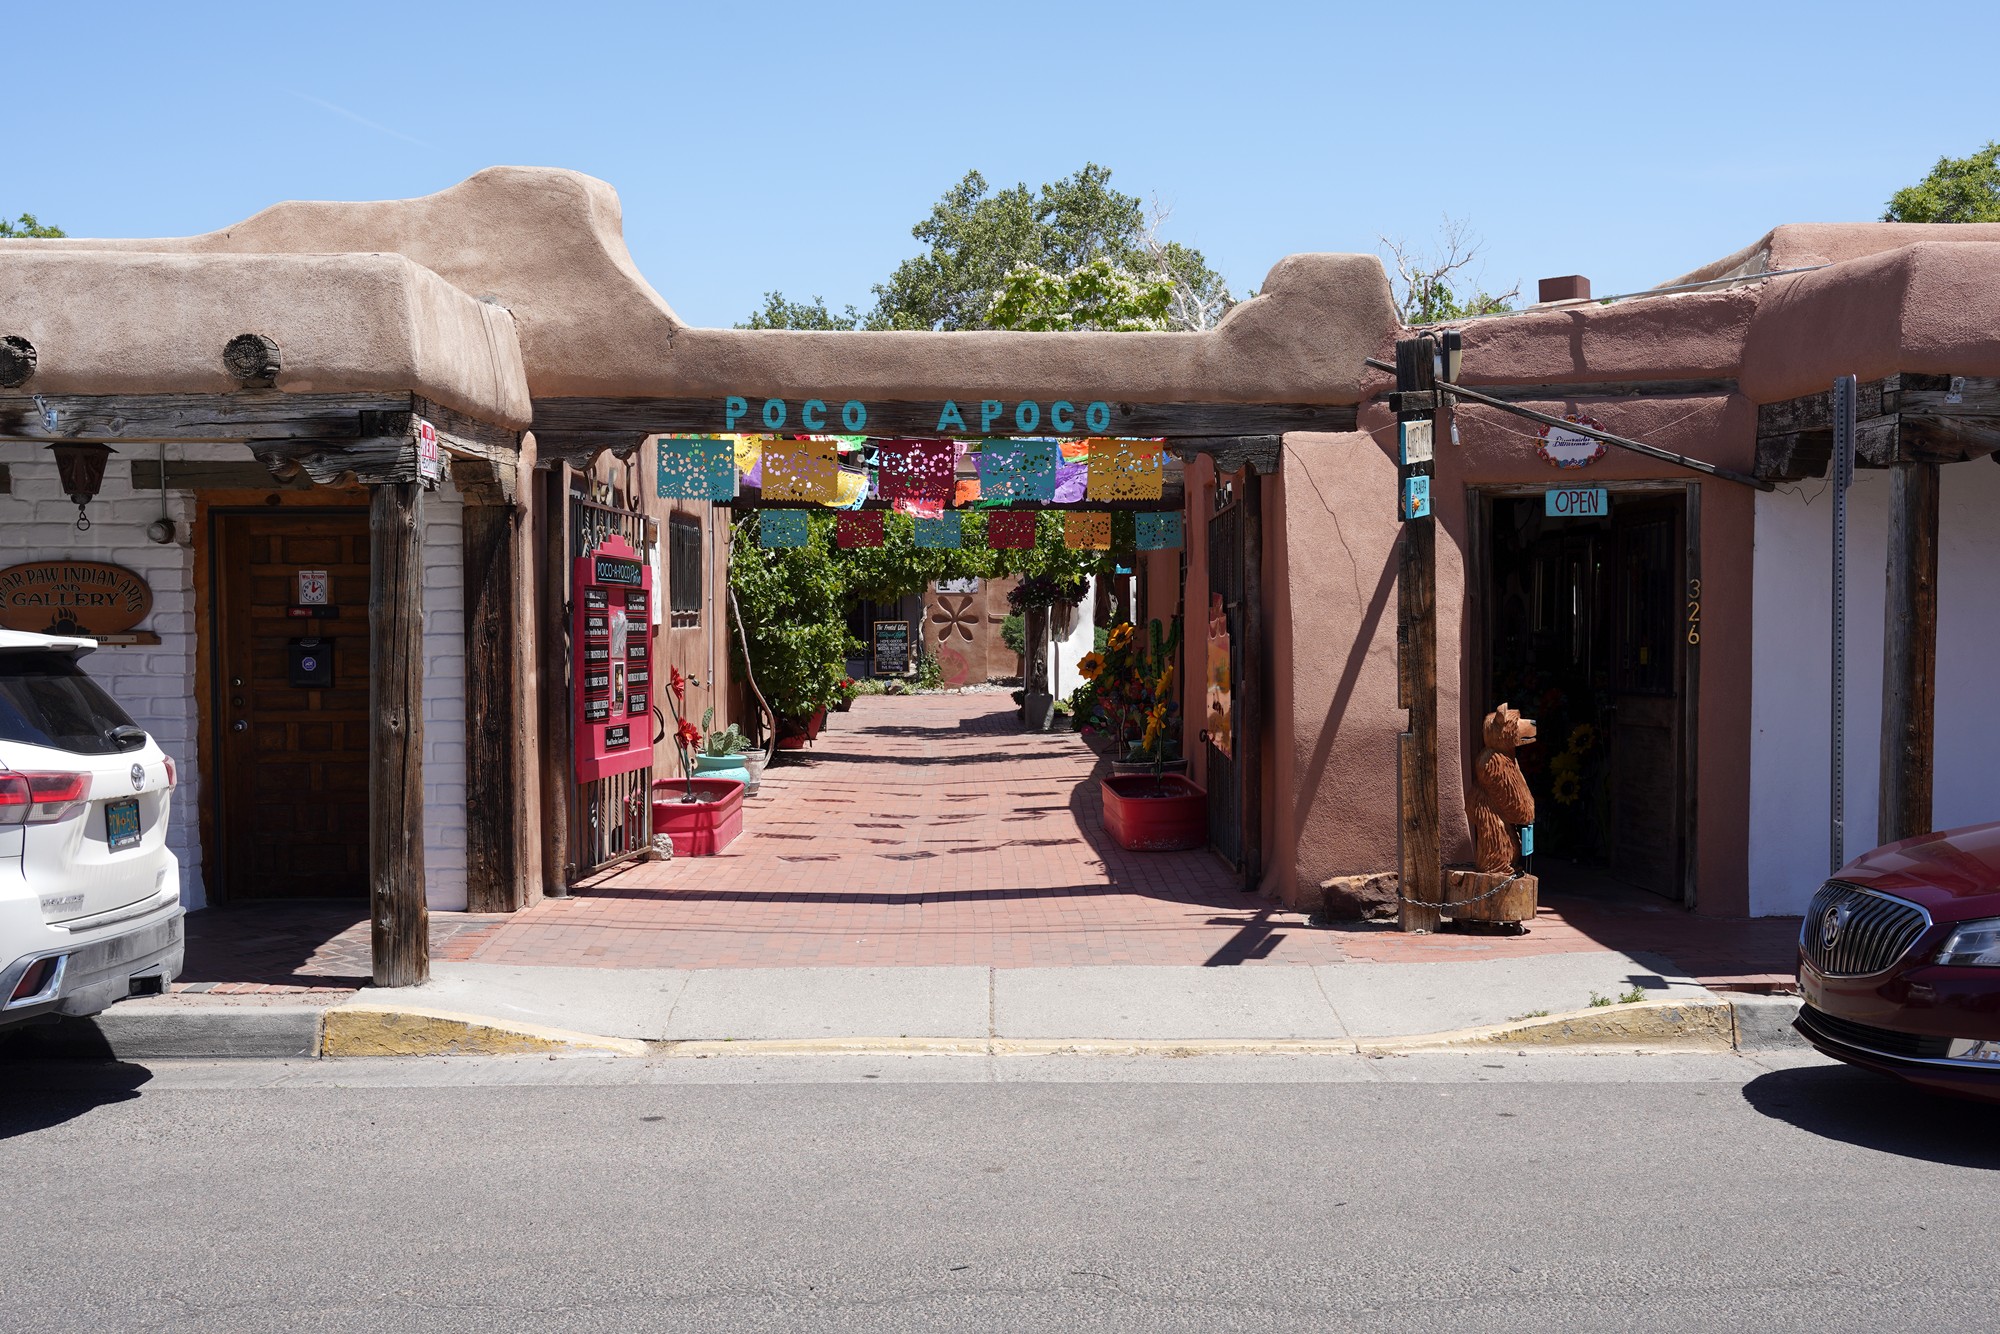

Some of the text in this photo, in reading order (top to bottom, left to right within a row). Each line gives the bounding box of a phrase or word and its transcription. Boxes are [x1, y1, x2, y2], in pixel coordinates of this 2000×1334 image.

[725, 396, 868, 431] POCO
[1555, 490, 1599, 514] OPEN
[12, 592, 120, 607] GALLERY
[25, 567, 59, 585] PAW
[64, 567, 119, 588] INDIAN
[116, 579, 144, 613] ARTS
[51, 584, 81, 592] AND
[1688, 579, 1701, 645] 326
